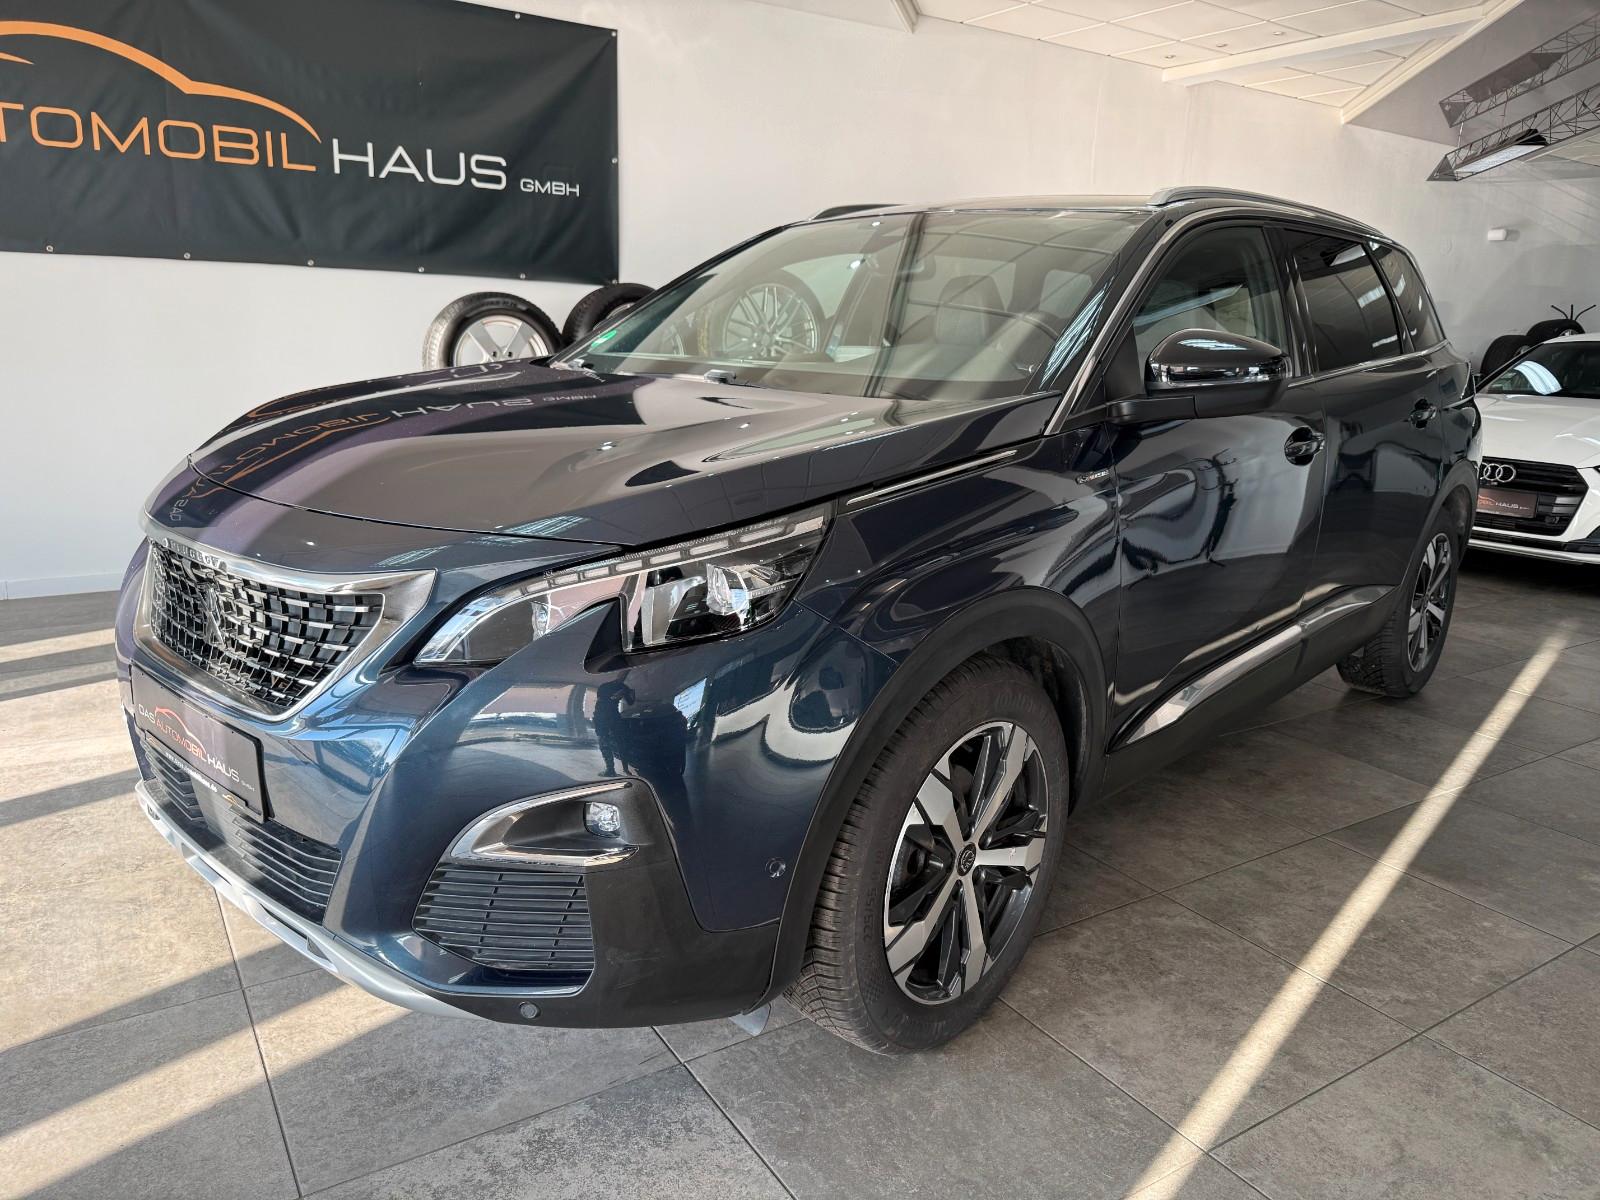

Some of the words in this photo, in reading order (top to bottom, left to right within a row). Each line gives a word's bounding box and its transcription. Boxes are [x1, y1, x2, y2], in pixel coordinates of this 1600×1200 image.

[332, 138, 507, 190] HAUS
[520, 178, 580, 197] GMBH
[138, 703, 156, 723] DAS
[156, 719, 206, 762] AUTOMOBIL
[206, 753, 240, 782] HAUS
